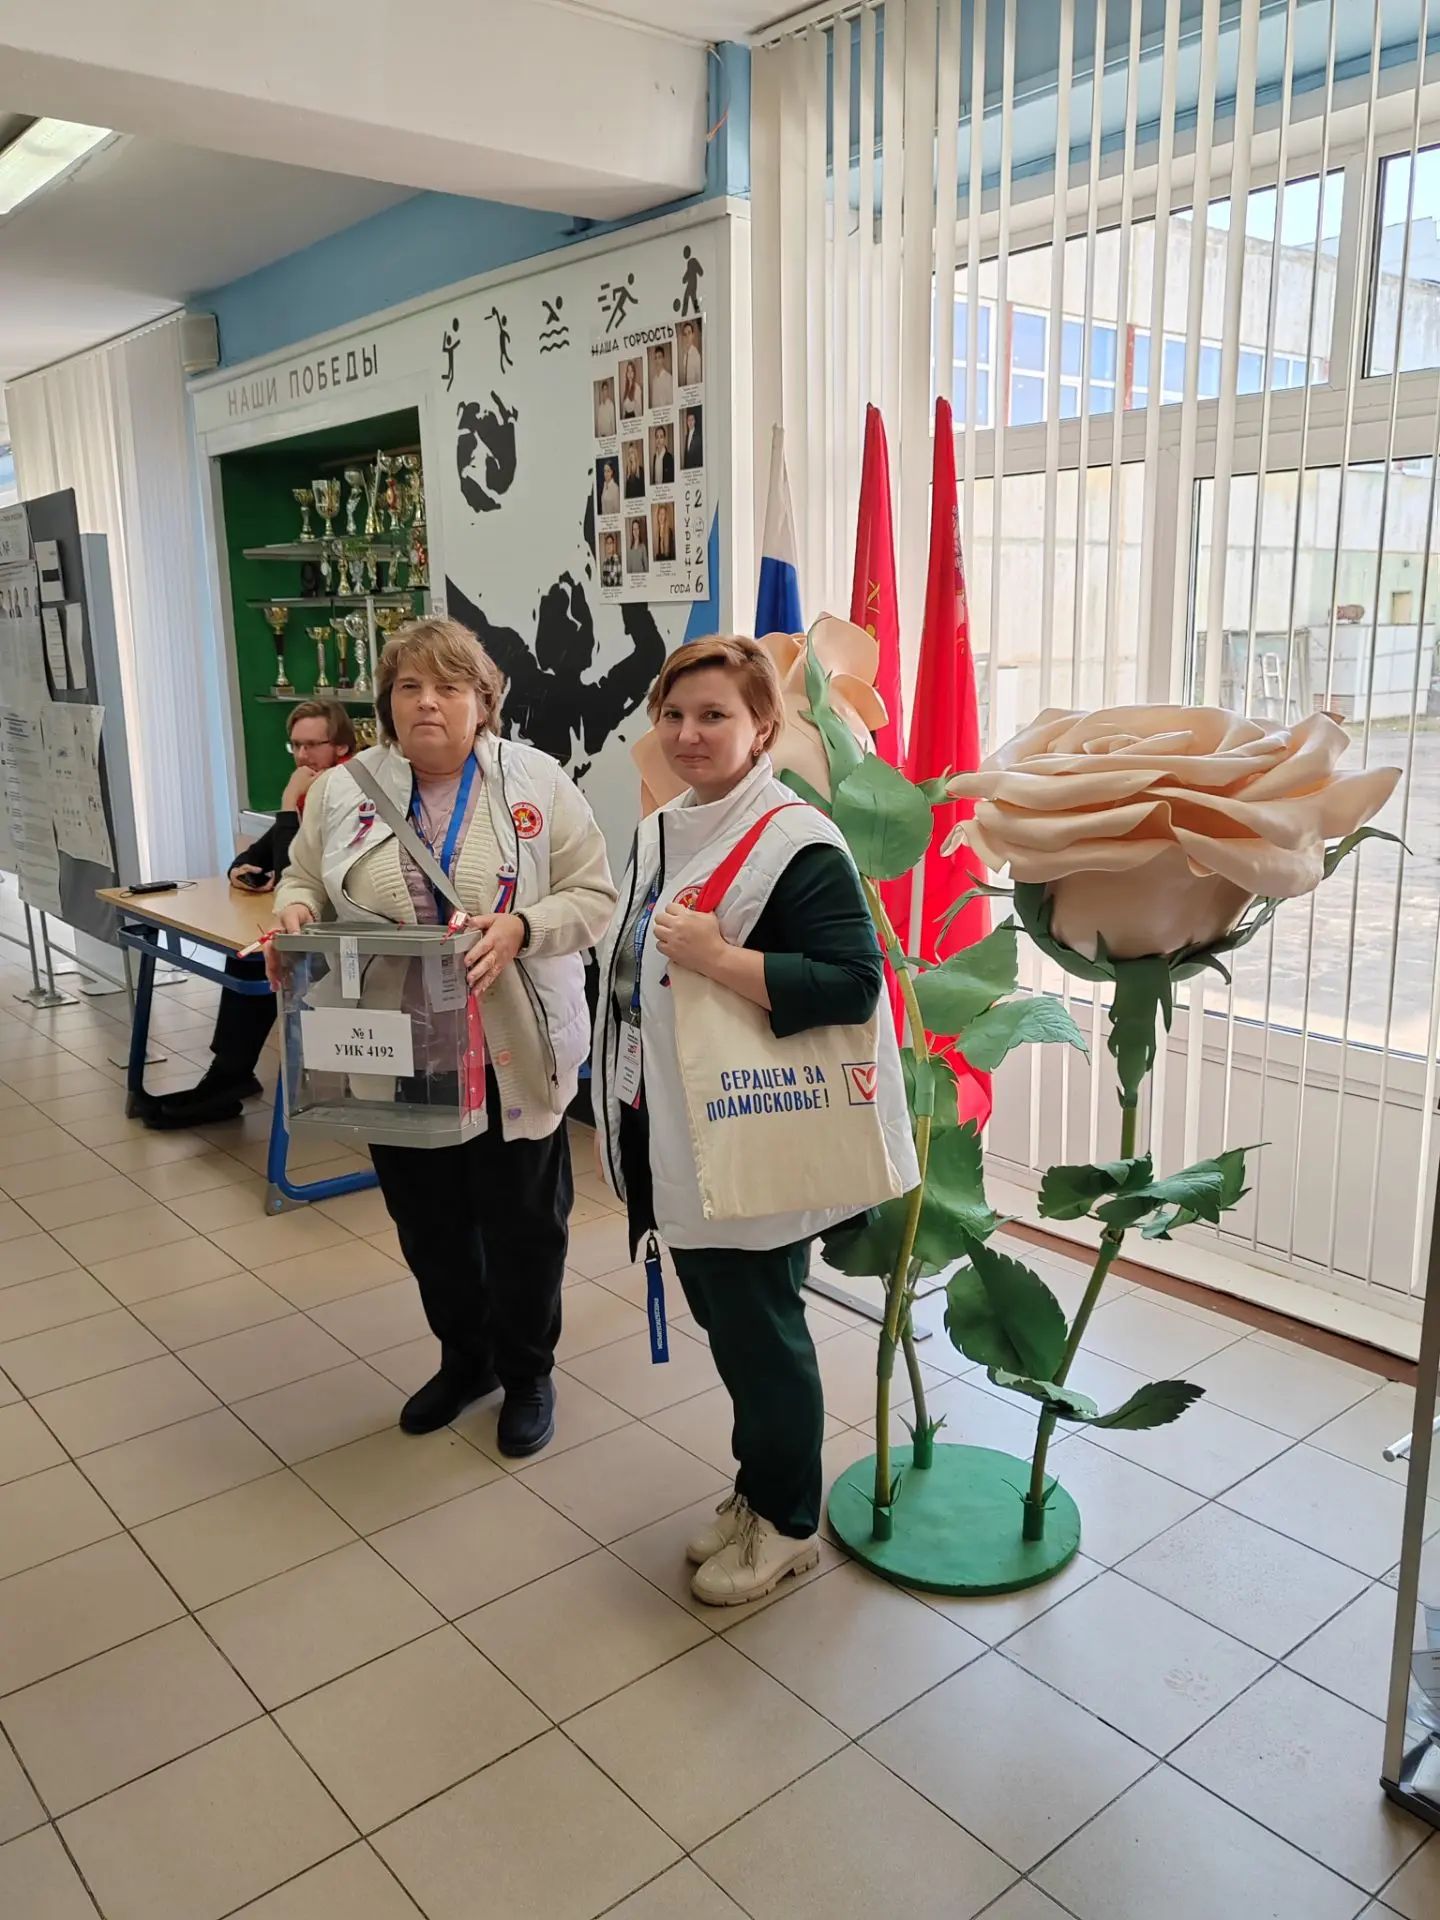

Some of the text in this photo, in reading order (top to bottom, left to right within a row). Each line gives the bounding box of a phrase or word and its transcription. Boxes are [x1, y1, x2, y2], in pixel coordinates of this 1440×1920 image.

[591, 338, 620, 357] НАША
[228, 344, 378, 417] НАШИ ПОБЕДЫ
[351, 1028, 374, 1039] № 1
[334, 1044, 394, 1057] УИК 4192
[720, 1065, 825, 1091] СЕРДЦЕМ ЗА
[706, 1088, 830, 1121] ПОДМОСКОВЬЕ!
